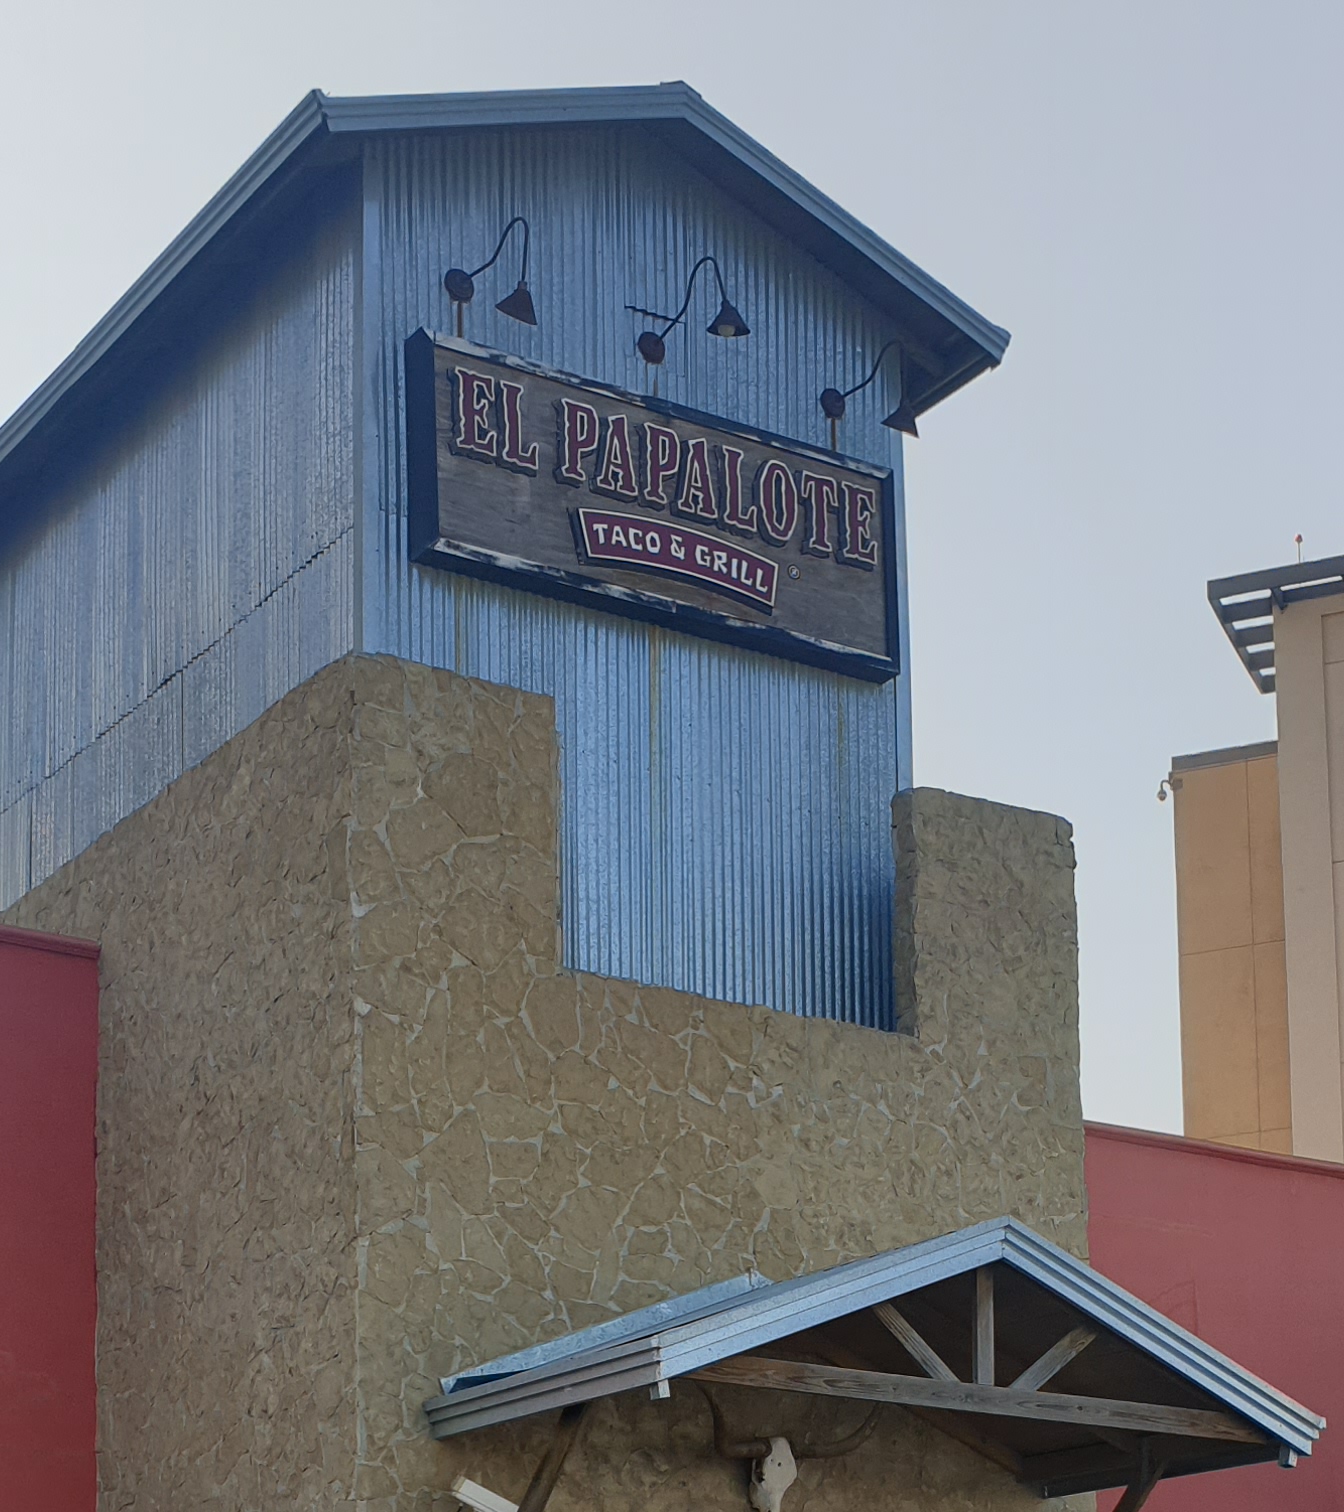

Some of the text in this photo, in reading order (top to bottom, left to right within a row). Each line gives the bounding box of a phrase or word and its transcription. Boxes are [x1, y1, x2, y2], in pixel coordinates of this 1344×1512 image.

[452, 365, 879, 567] EL PAPALOTE
[591, 522, 770, 594] TACO & GRILL
